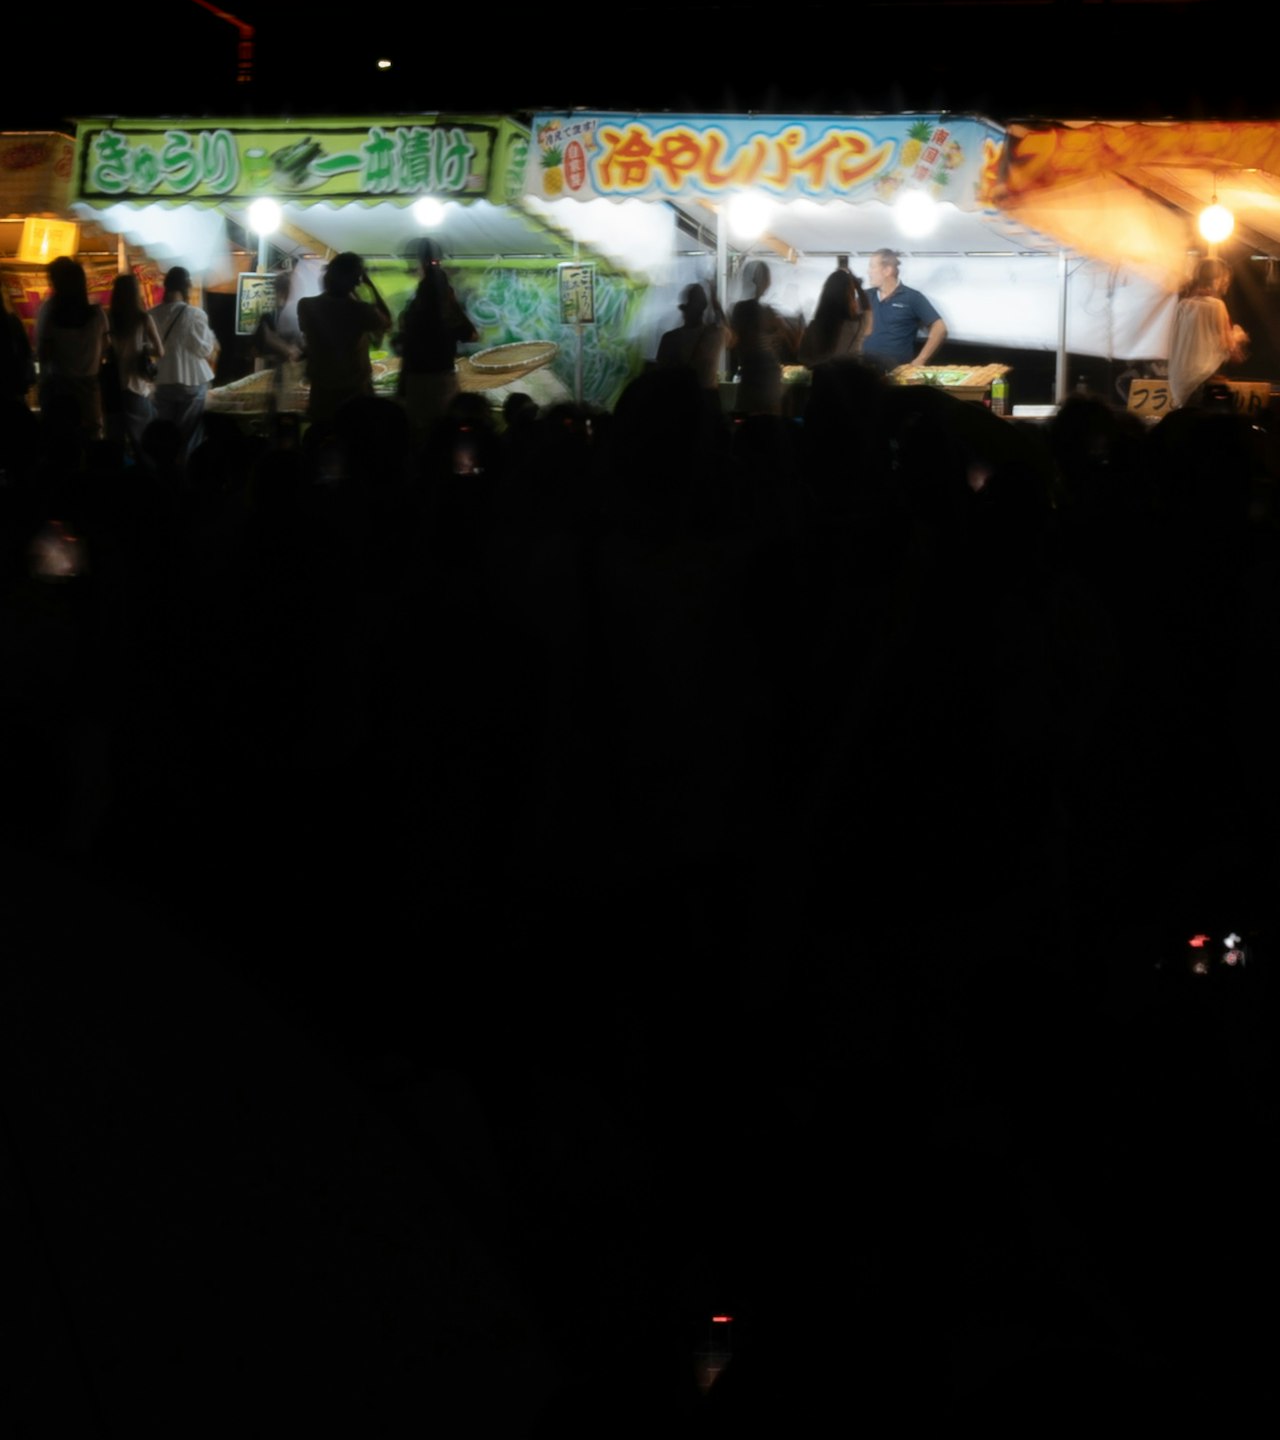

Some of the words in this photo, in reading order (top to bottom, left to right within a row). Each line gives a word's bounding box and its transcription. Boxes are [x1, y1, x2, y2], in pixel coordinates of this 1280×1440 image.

[93, 129, 239, 195] きゅうり
[308, 126, 476, 195] 一本漬け
[600, 124, 892, 189] 冷やしパイン
